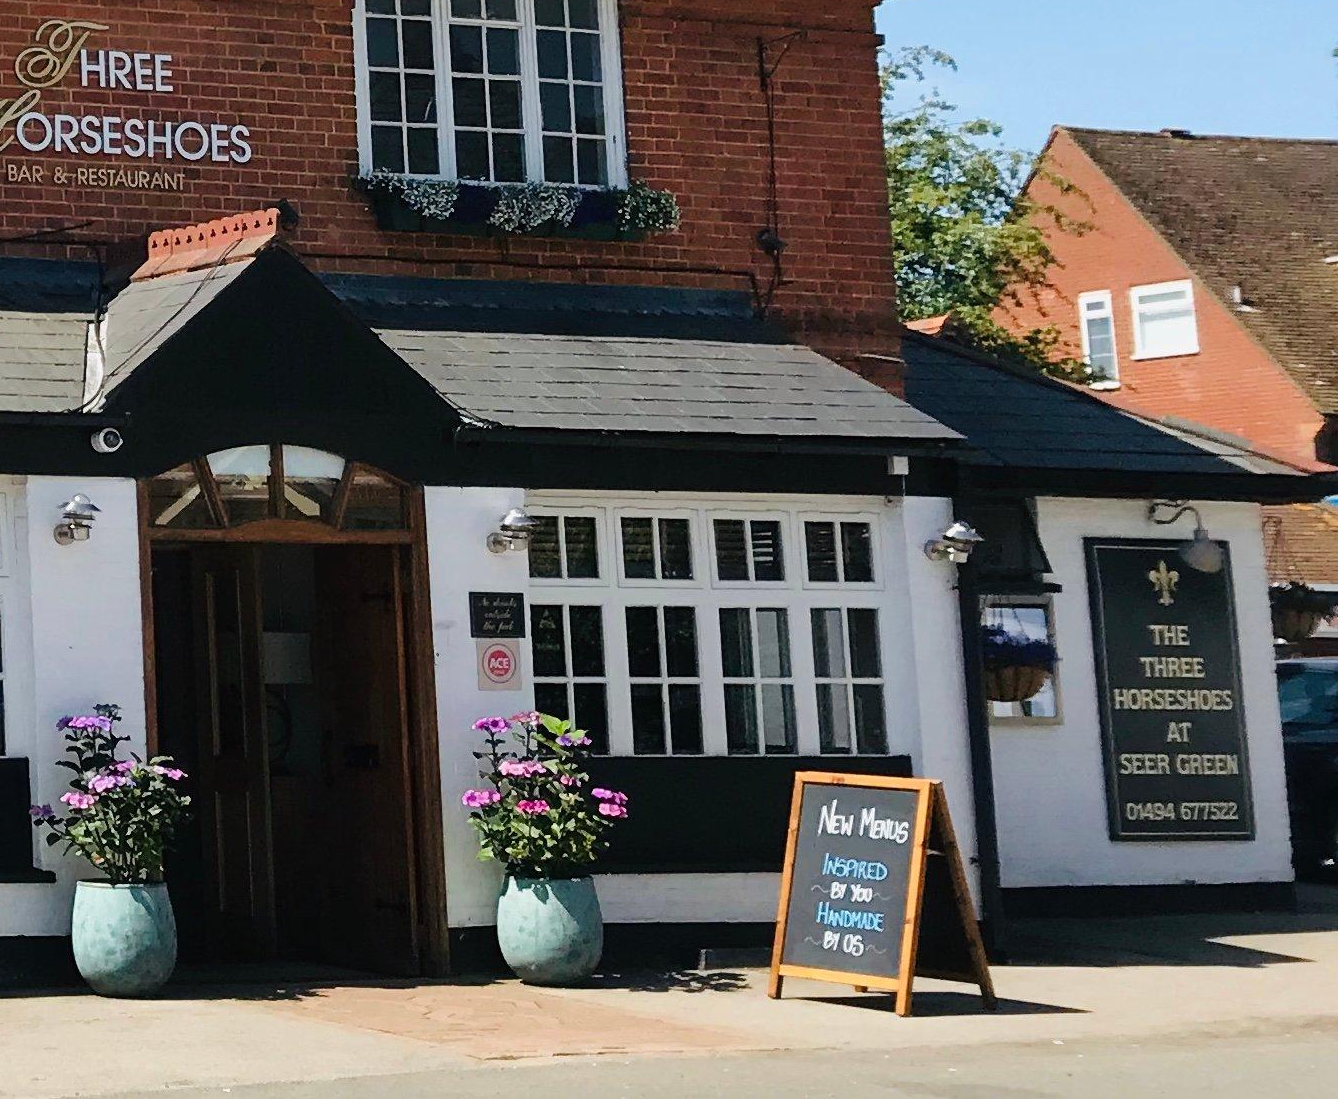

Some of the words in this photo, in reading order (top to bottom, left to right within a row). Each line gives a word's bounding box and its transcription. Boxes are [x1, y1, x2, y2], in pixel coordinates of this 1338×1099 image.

[15, 19, 173, 92] THREE
[7, 163, 42, 183] BAR
[53, 168, 68, 183] &
[77, 167, 186, 191] RESTAURANT
[1147, 625, 1190, 646] THE
[1140, 657, 1205, 678] THREE
[1114, 689, 1233, 710] HORSESHOES
[1166, 722, 1192, 742] AT
[1120, 754, 1171, 774] SEER
[1176, 754, 1239, 774] GREEN
[1126, 802, 1174, 820] 01494
[1180, 802, 1238, 820] 677522
[859, 807, 910, 844] MENUS
[822, 853, 888, 881] INSPIRED
[830, 882, 847, 897] BY
[851, 883, 873, 902] YOU
[816, 902, 885, 933] HANDMADE
[822, 931, 839, 950] BY
